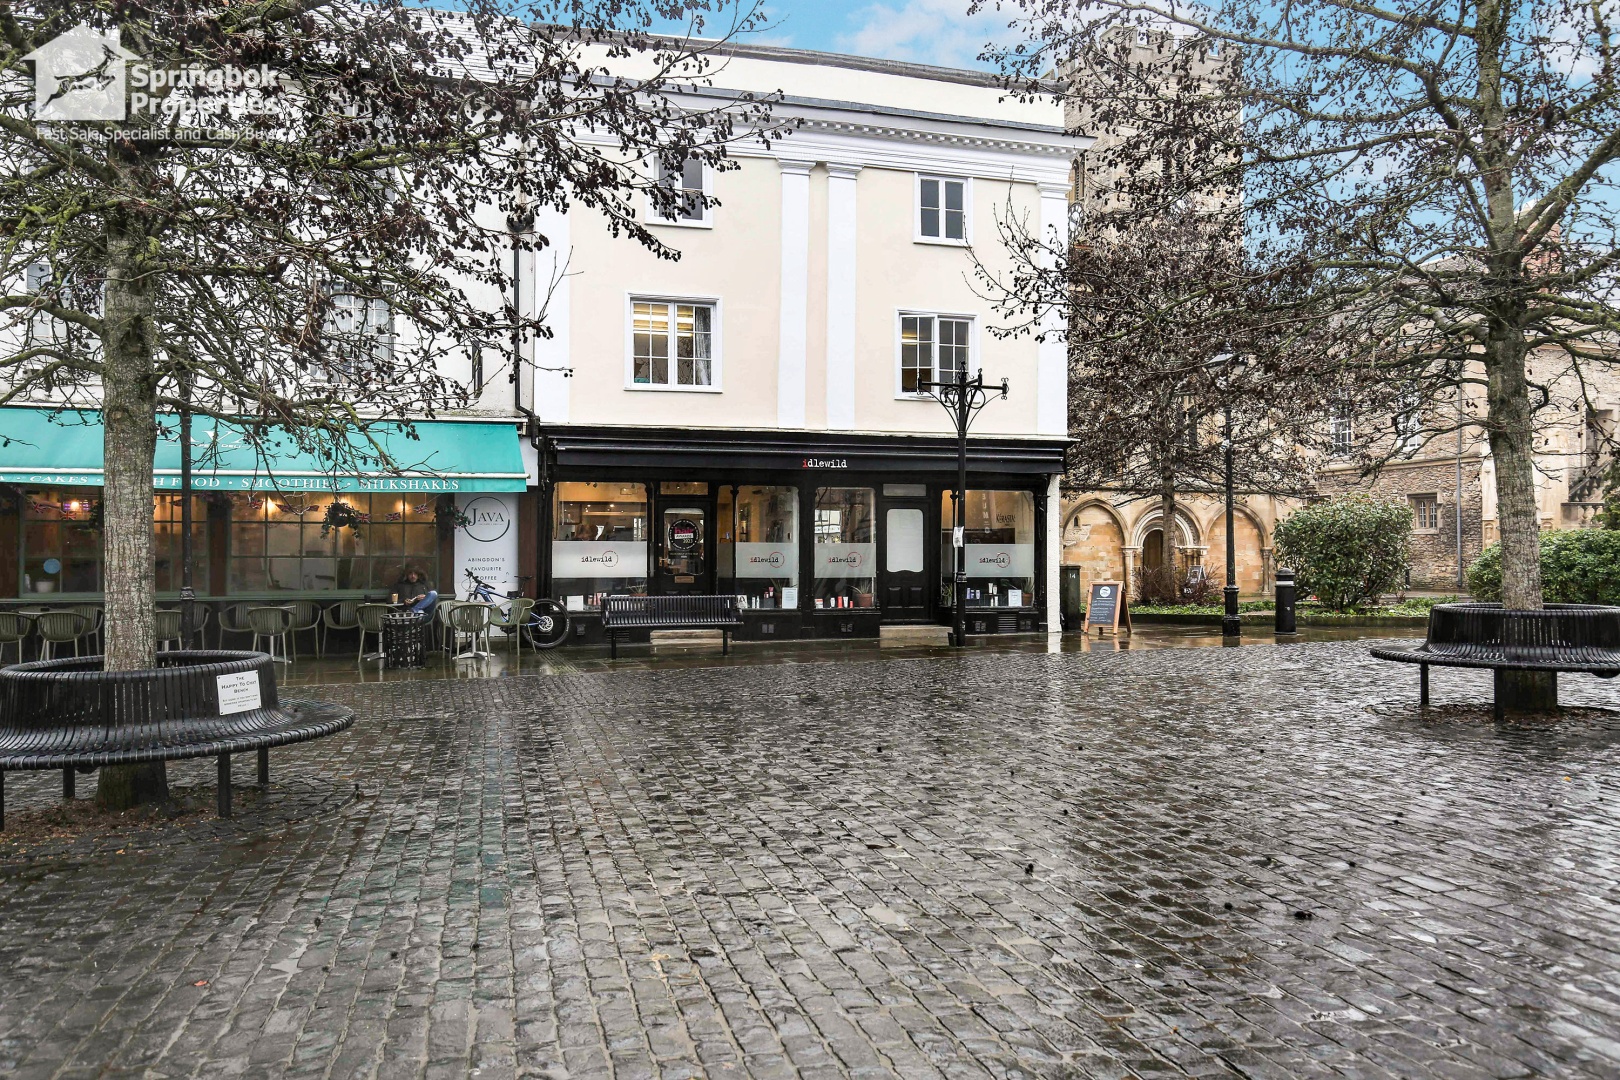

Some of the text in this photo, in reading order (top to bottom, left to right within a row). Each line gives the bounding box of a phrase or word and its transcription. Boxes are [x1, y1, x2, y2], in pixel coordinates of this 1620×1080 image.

[802, 458, 848, 468] idlewild
[30, 475, 88, 484] CAKES
[171, 477, 220, 487] FOD
[360, 479, 459, 490] MILKSHAKES
